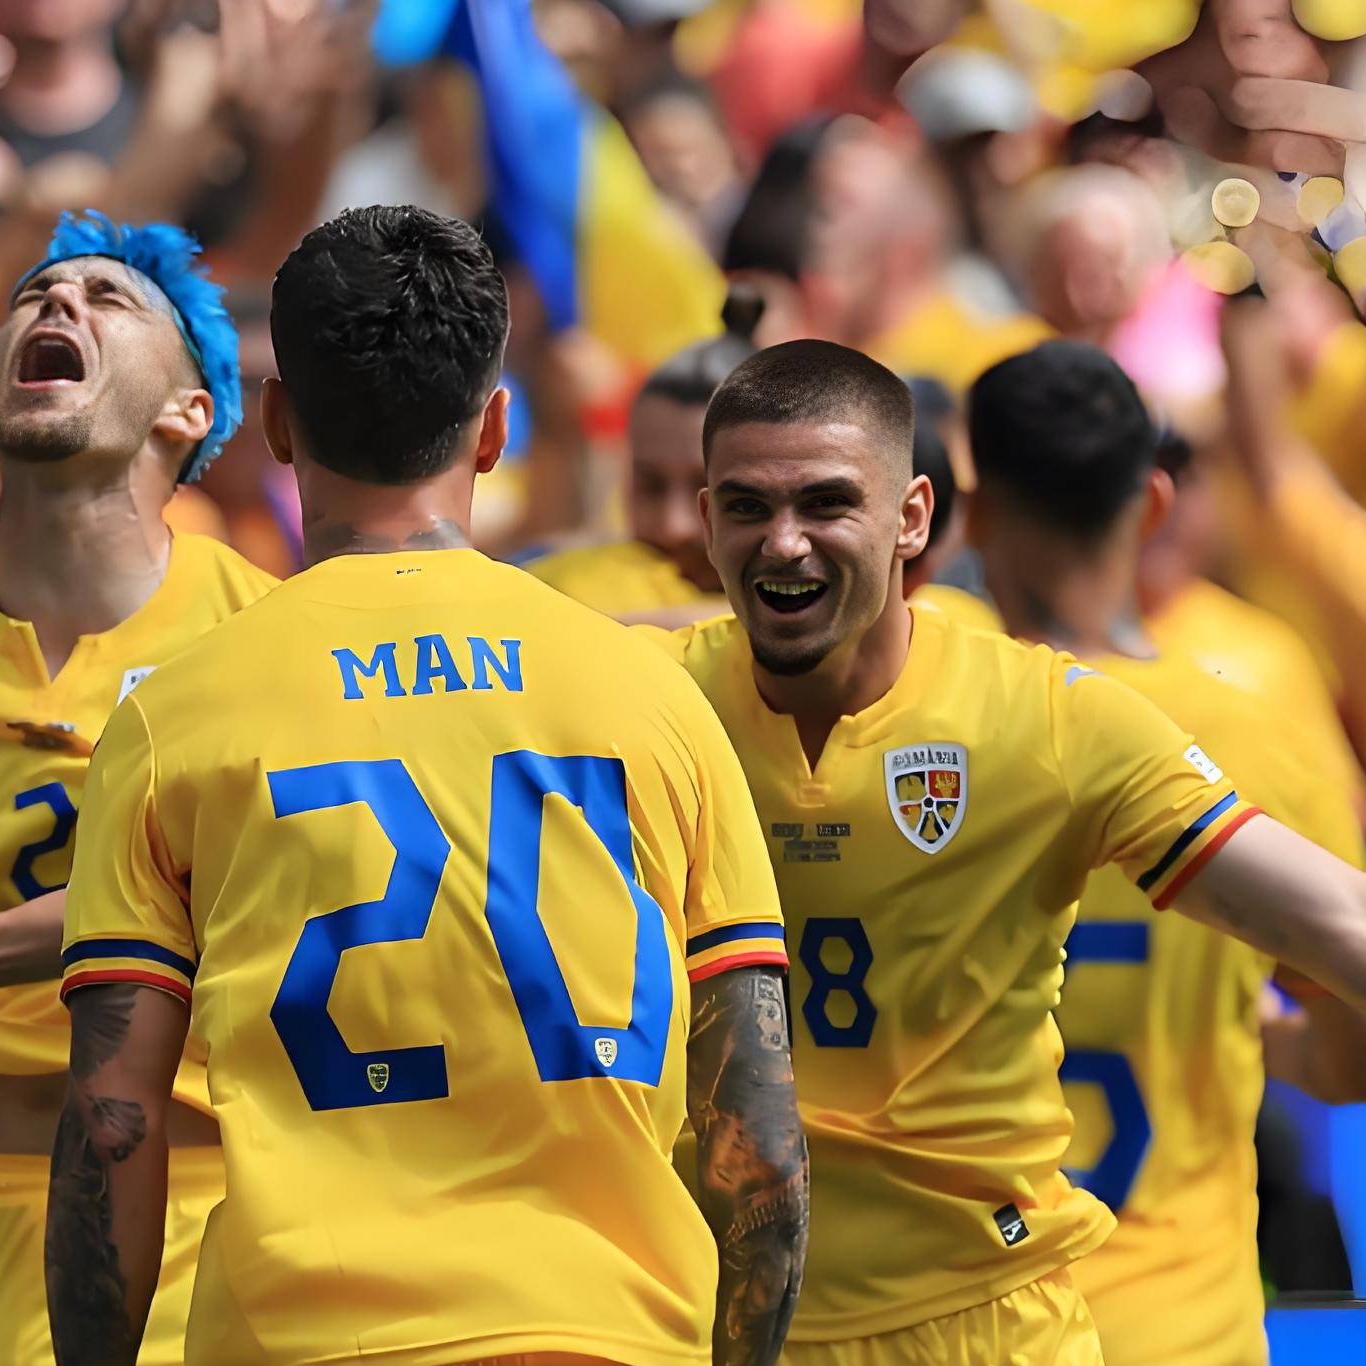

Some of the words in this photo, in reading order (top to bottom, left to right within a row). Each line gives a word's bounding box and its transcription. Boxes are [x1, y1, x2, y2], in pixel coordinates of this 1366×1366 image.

[331, 633, 523, 700] MAN
[266, 748, 674, 1112] 20
[784, 917, 877, 1048] 8
